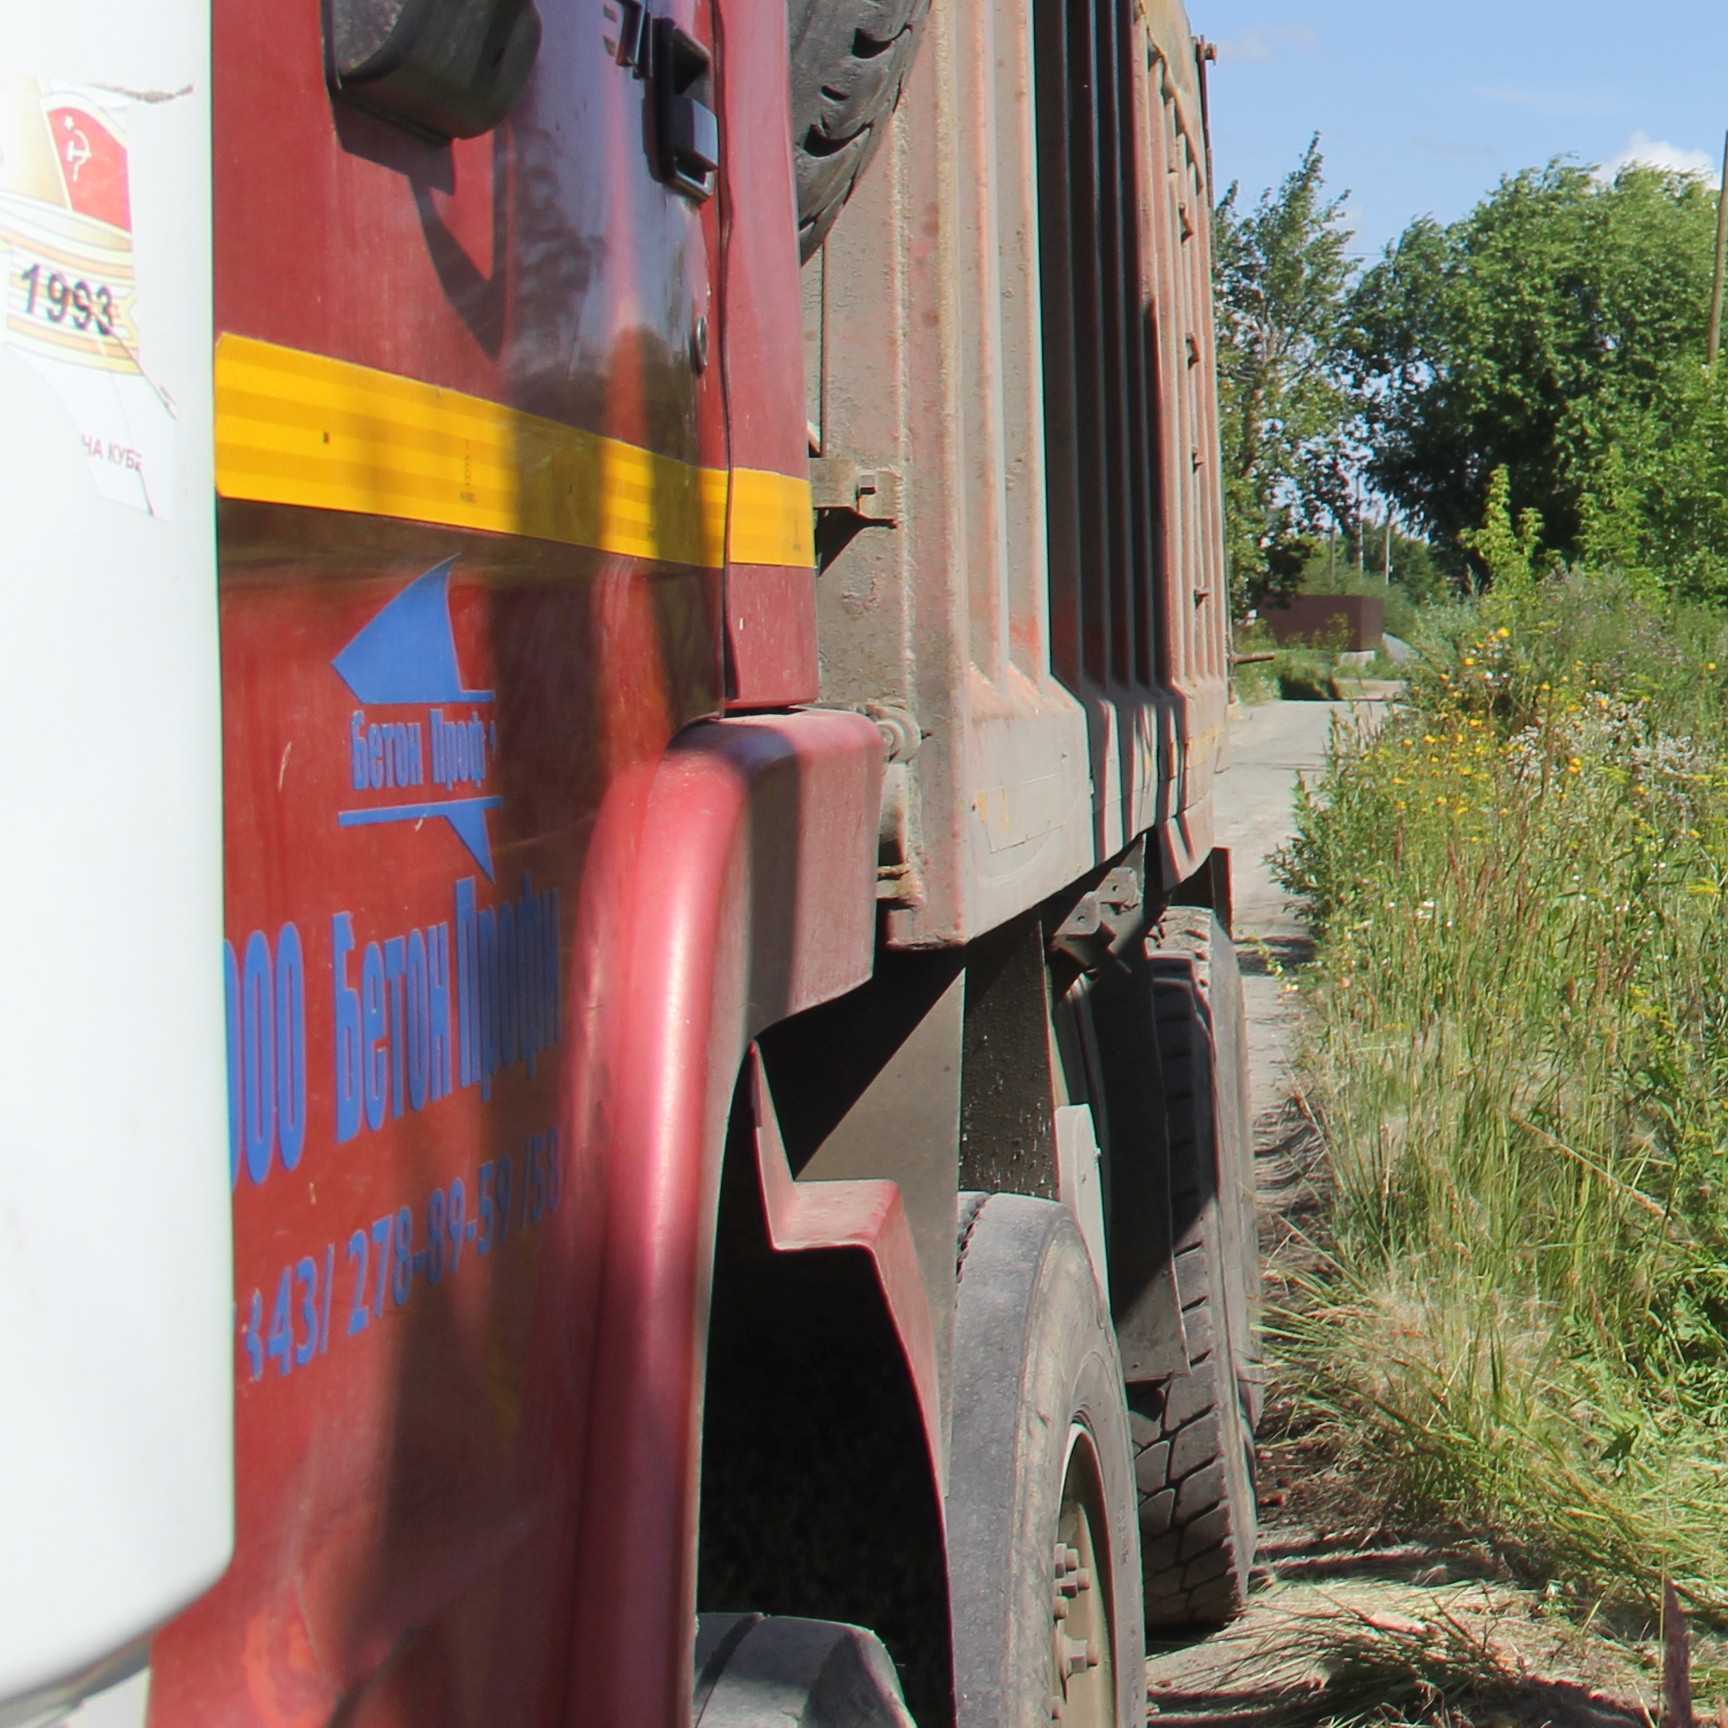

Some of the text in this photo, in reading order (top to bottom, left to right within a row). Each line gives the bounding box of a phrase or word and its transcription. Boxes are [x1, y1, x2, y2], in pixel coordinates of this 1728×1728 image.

[21, 261, 116, 336] 1993
[351, 708, 498, 791] Бетон Проф
